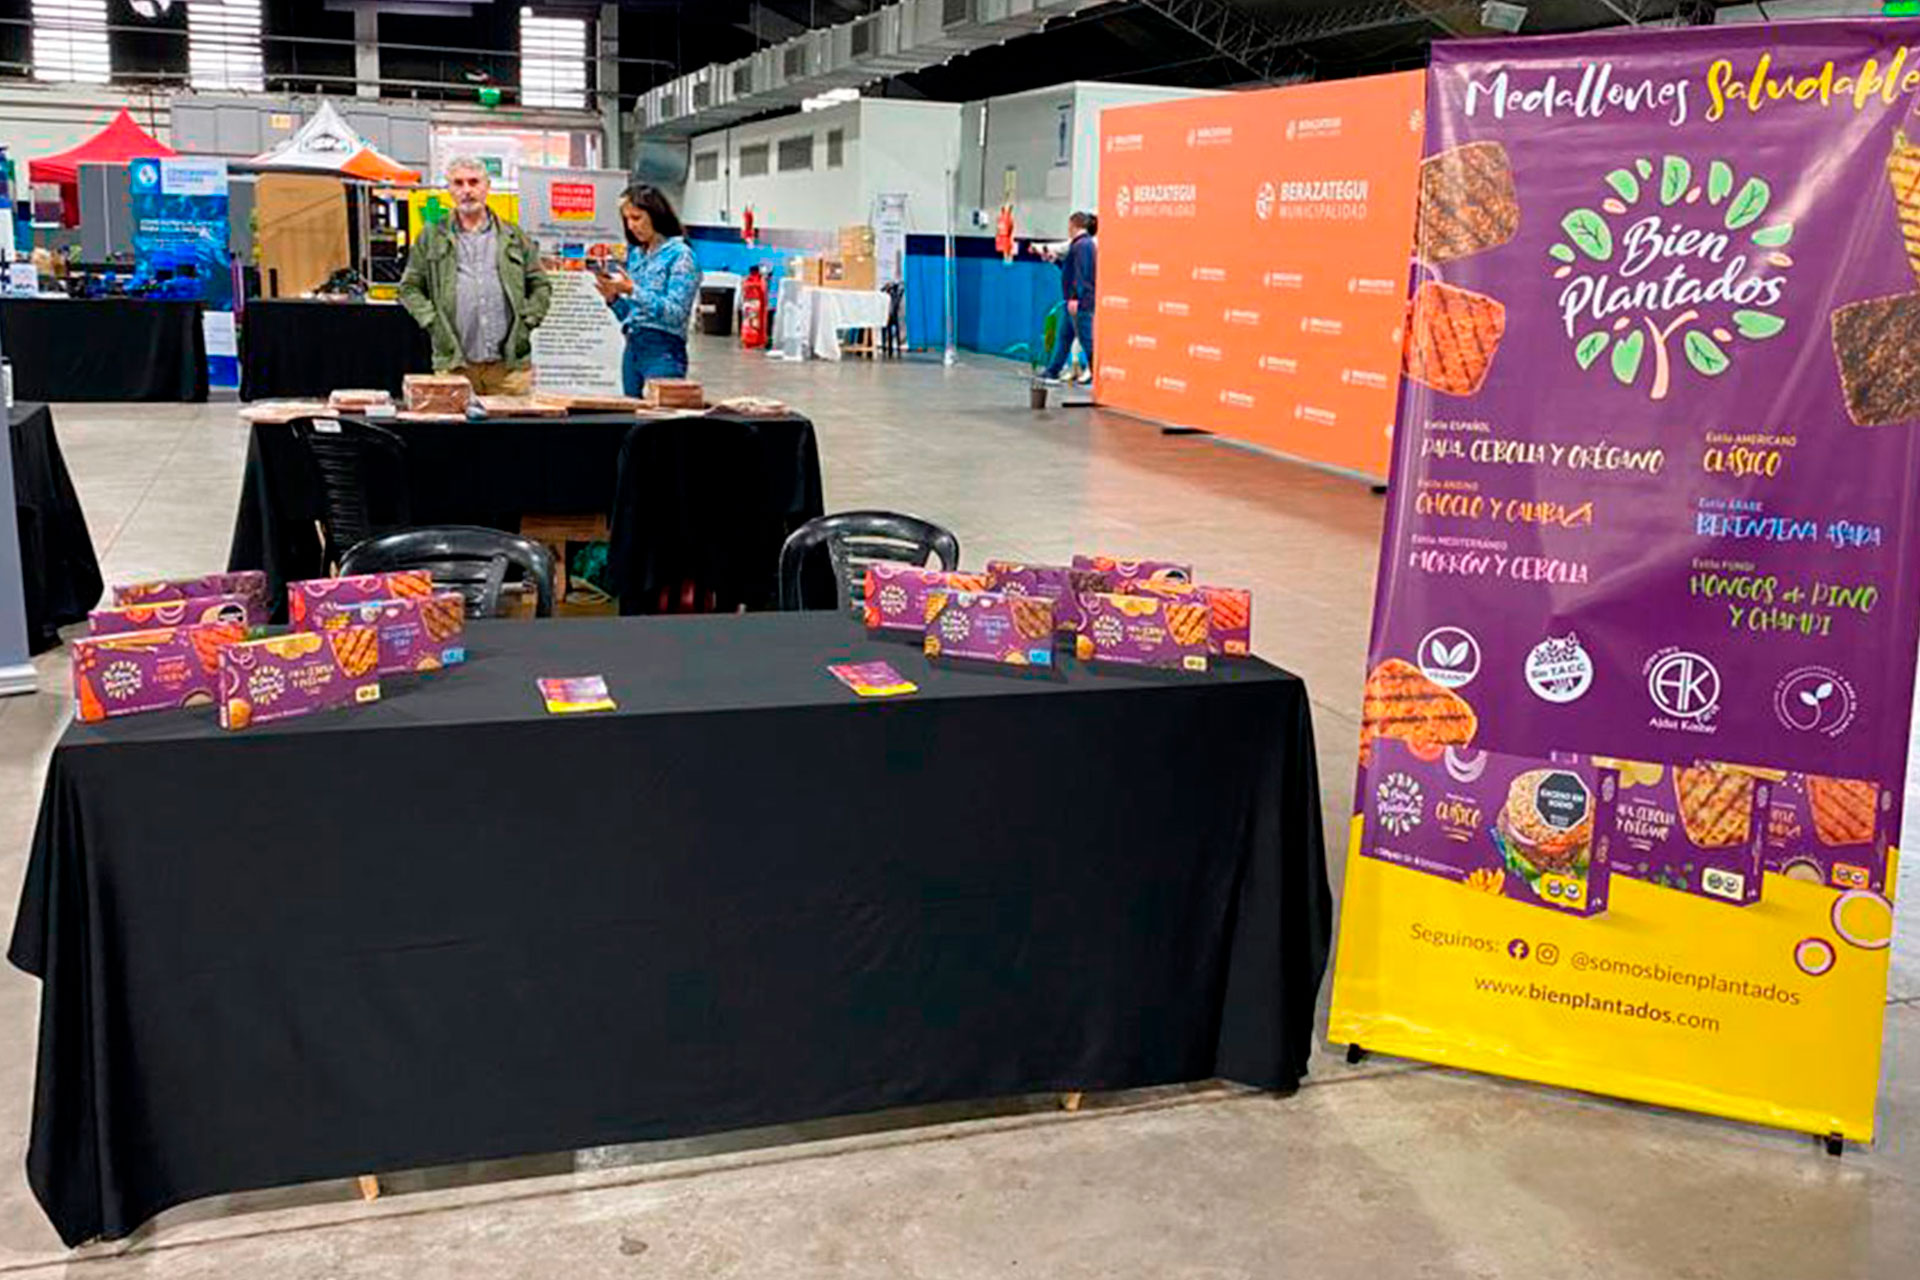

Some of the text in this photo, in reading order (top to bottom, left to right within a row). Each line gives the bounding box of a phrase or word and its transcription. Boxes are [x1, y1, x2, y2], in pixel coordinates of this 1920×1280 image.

[1465, 46, 1920, 125] Medallones Saludable
[1134, 184, 1196, 202] BERAZATEGUI
[1281, 181, 1367, 201] BERAZATEGUI
[1280, 203, 1366, 219] MUNICIPALIDAD
[1619, 216, 1729, 276] Bien
[1560, 256, 1786, 338] Plantados
[1470, 440, 1545, 464] CEBOLLA
[1550, 443, 1565, 466] Y
[1568, 440, 1665, 474] ORÉGANO
[1703, 445, 1781, 477] CLÁSICO
[1415, 491, 1593, 528] CHOCLO Y CALABAZA
[1696, 512, 1881, 549] BERENJENA ASADA
[1409, 549, 1588, 583] MORRÓN Y CEBOLLA
[1690, 573, 1778, 604] HONGOS
[1811, 581, 1878, 613] PINO
[1729, 604, 1832, 636] Y CHAMPI
[1410, 923, 1499, 954] Seguinos:
[1571, 951, 1800, 1007] @somosbienplantados
[1475, 975, 1720, 1033] www.bienplantados.com
